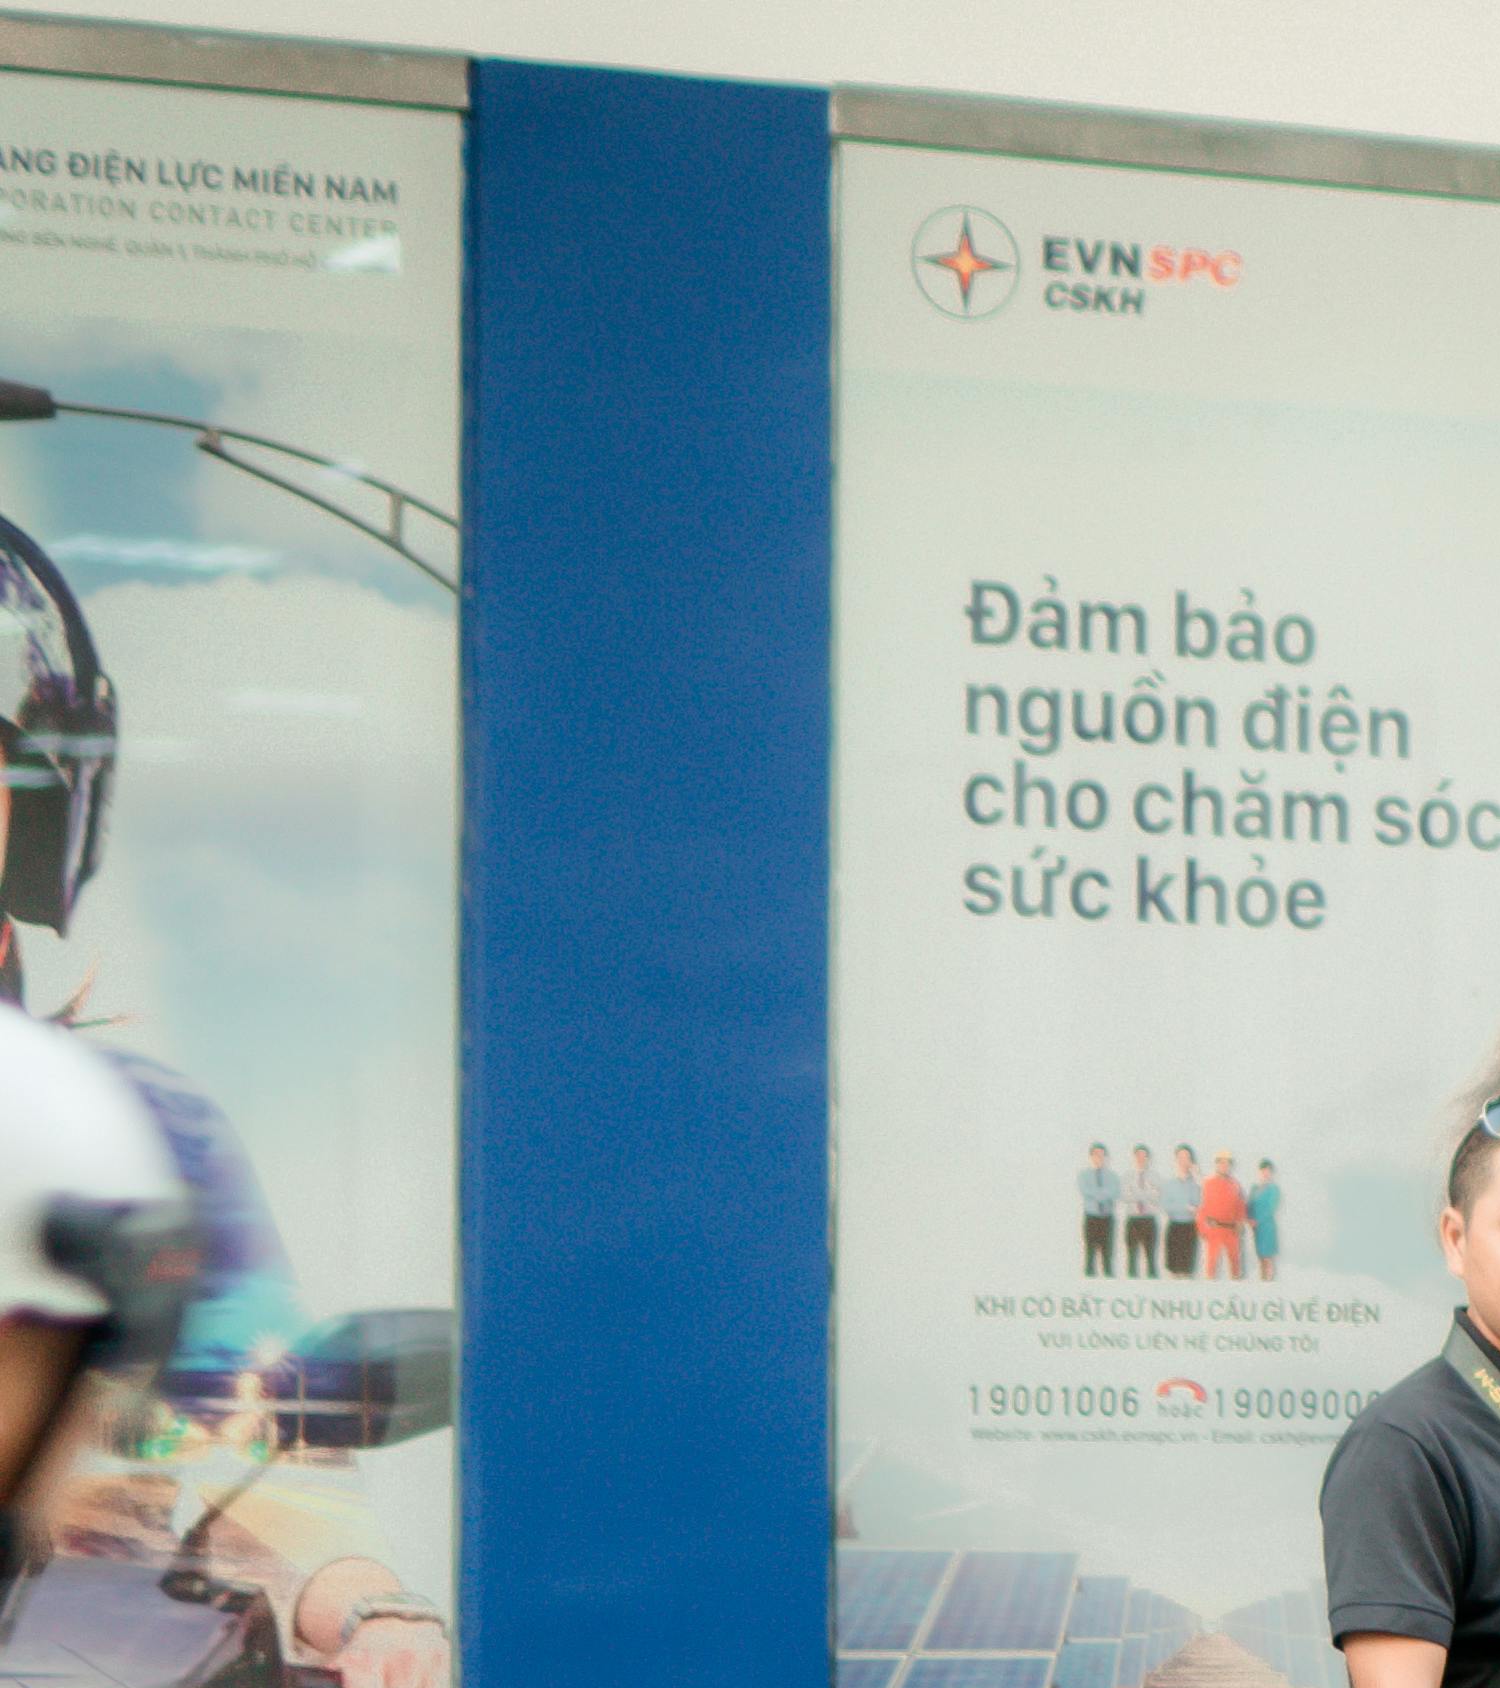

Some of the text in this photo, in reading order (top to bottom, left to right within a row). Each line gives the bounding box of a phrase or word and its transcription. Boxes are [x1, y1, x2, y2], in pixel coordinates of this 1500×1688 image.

[0, 145, 399, 205] NG ĐIỆN LỰC MIỀN NAM
[150, 199, 278, 232] CONTACT
[289, 210, 399, 238] CENTER
[1044, 282, 1145, 316] CSKH
[963, 574, 1318, 667] Đảm bảo
[963, 669, 1413, 775] nguồn điện
[963, 759, 1111, 832] cho
[1132, 768, 1352, 844] chăm
[963, 845, 1328, 931] sức khỏe
[974, 1295, 1015, 1318] KHI
[1021, 1294, 1056, 1319] CÓ
[1151, 1298, 1201, 1321] NHU
[1326, 1297, 1381, 1327] ĐIỆN
[969, 1384, 1140, 1417] 19001006
